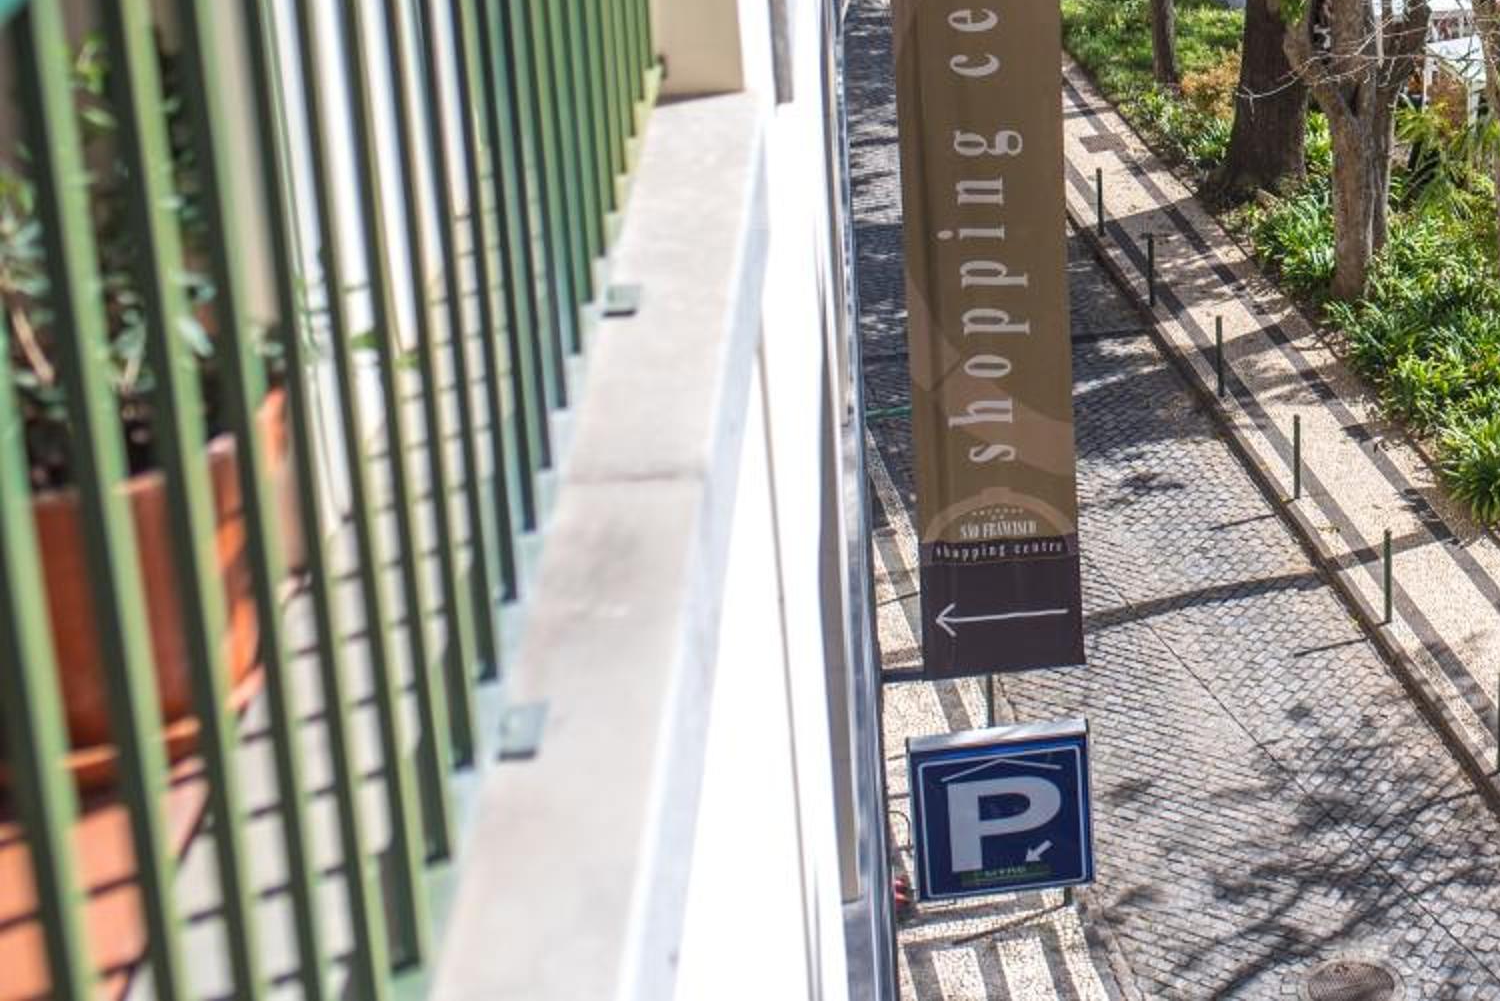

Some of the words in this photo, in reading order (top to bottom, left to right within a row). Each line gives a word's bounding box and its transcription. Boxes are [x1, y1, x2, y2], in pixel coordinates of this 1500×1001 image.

[936, 130, 1031, 463] shopping
[935, 544, 1006, 562] shopping
[947, 775, 1062, 873] P
